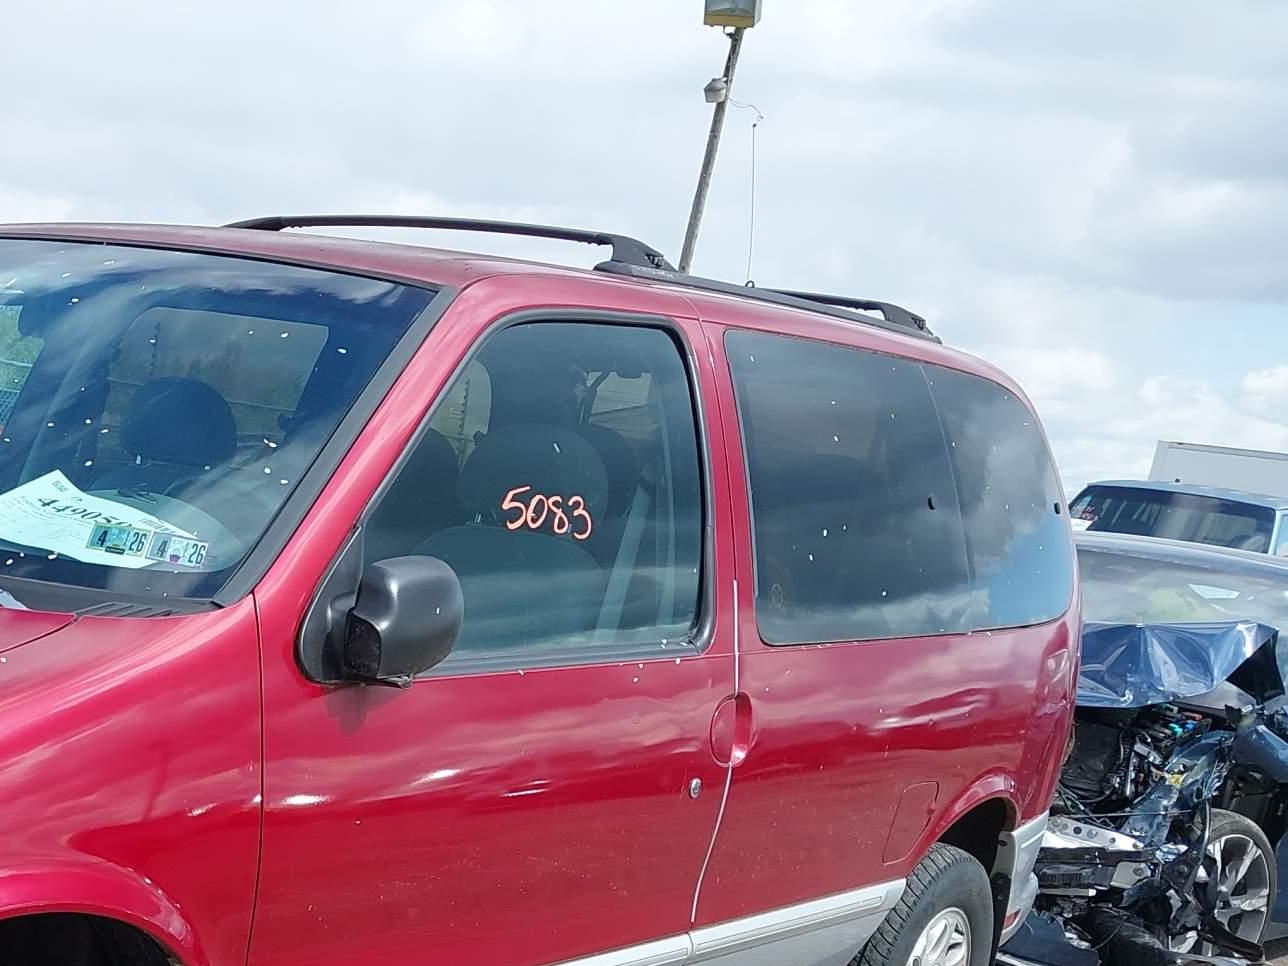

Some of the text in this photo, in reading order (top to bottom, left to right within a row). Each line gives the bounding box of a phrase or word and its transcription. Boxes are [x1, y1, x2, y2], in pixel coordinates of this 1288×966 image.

[500, 485, 593, 541] 5083
[95, 529, 147, 553] 4 26
[187, 543, 206, 565] 26
